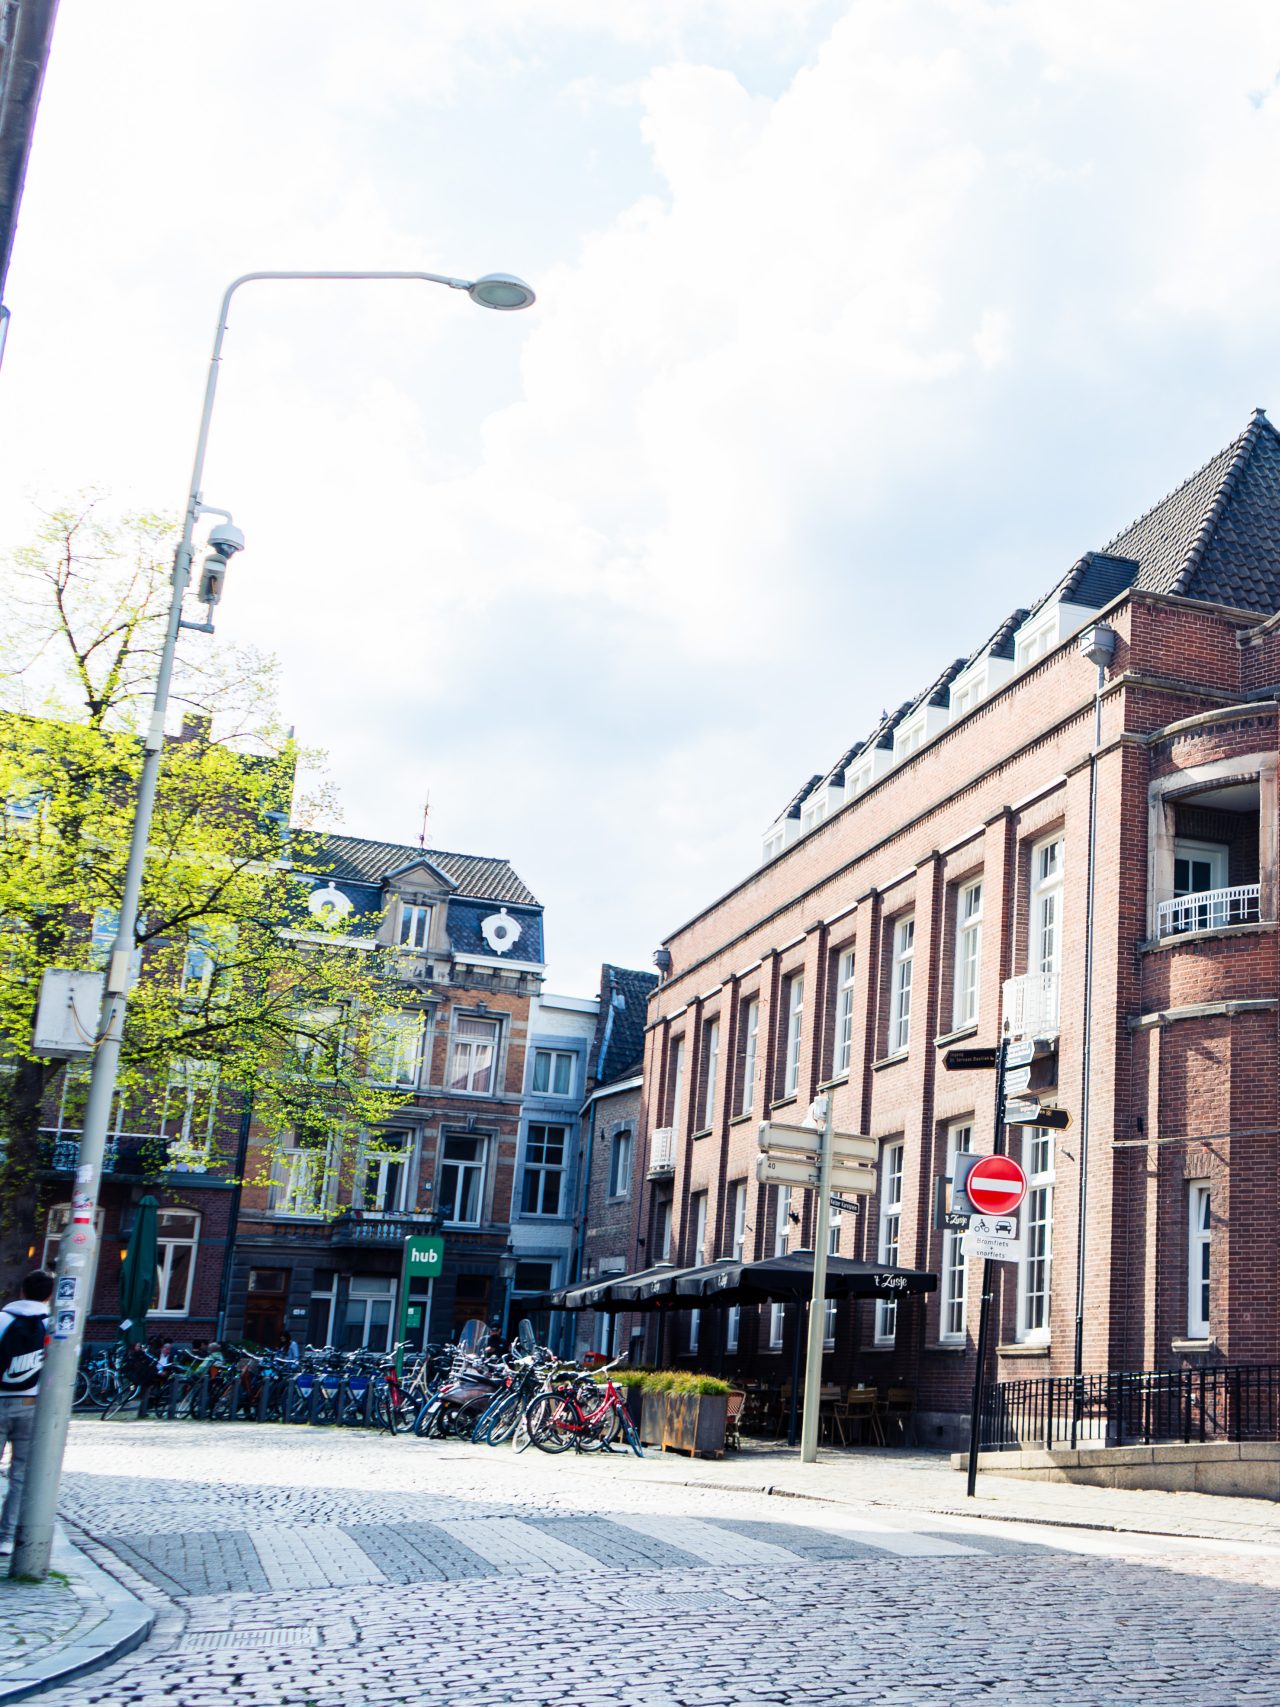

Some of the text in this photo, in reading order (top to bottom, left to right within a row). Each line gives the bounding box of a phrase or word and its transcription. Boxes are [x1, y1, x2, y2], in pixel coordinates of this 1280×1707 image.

[767, 1162, 776, 1170] 40
[976, 1238, 1009, 1248] Bromfiets
[411, 1248, 438, 1263] hub
[976, 1250, 1006, 1259] snorfiets
[873, 1273, 908, 1290] 't Zusje
[8, 1349, 45, 1374] NIKE
